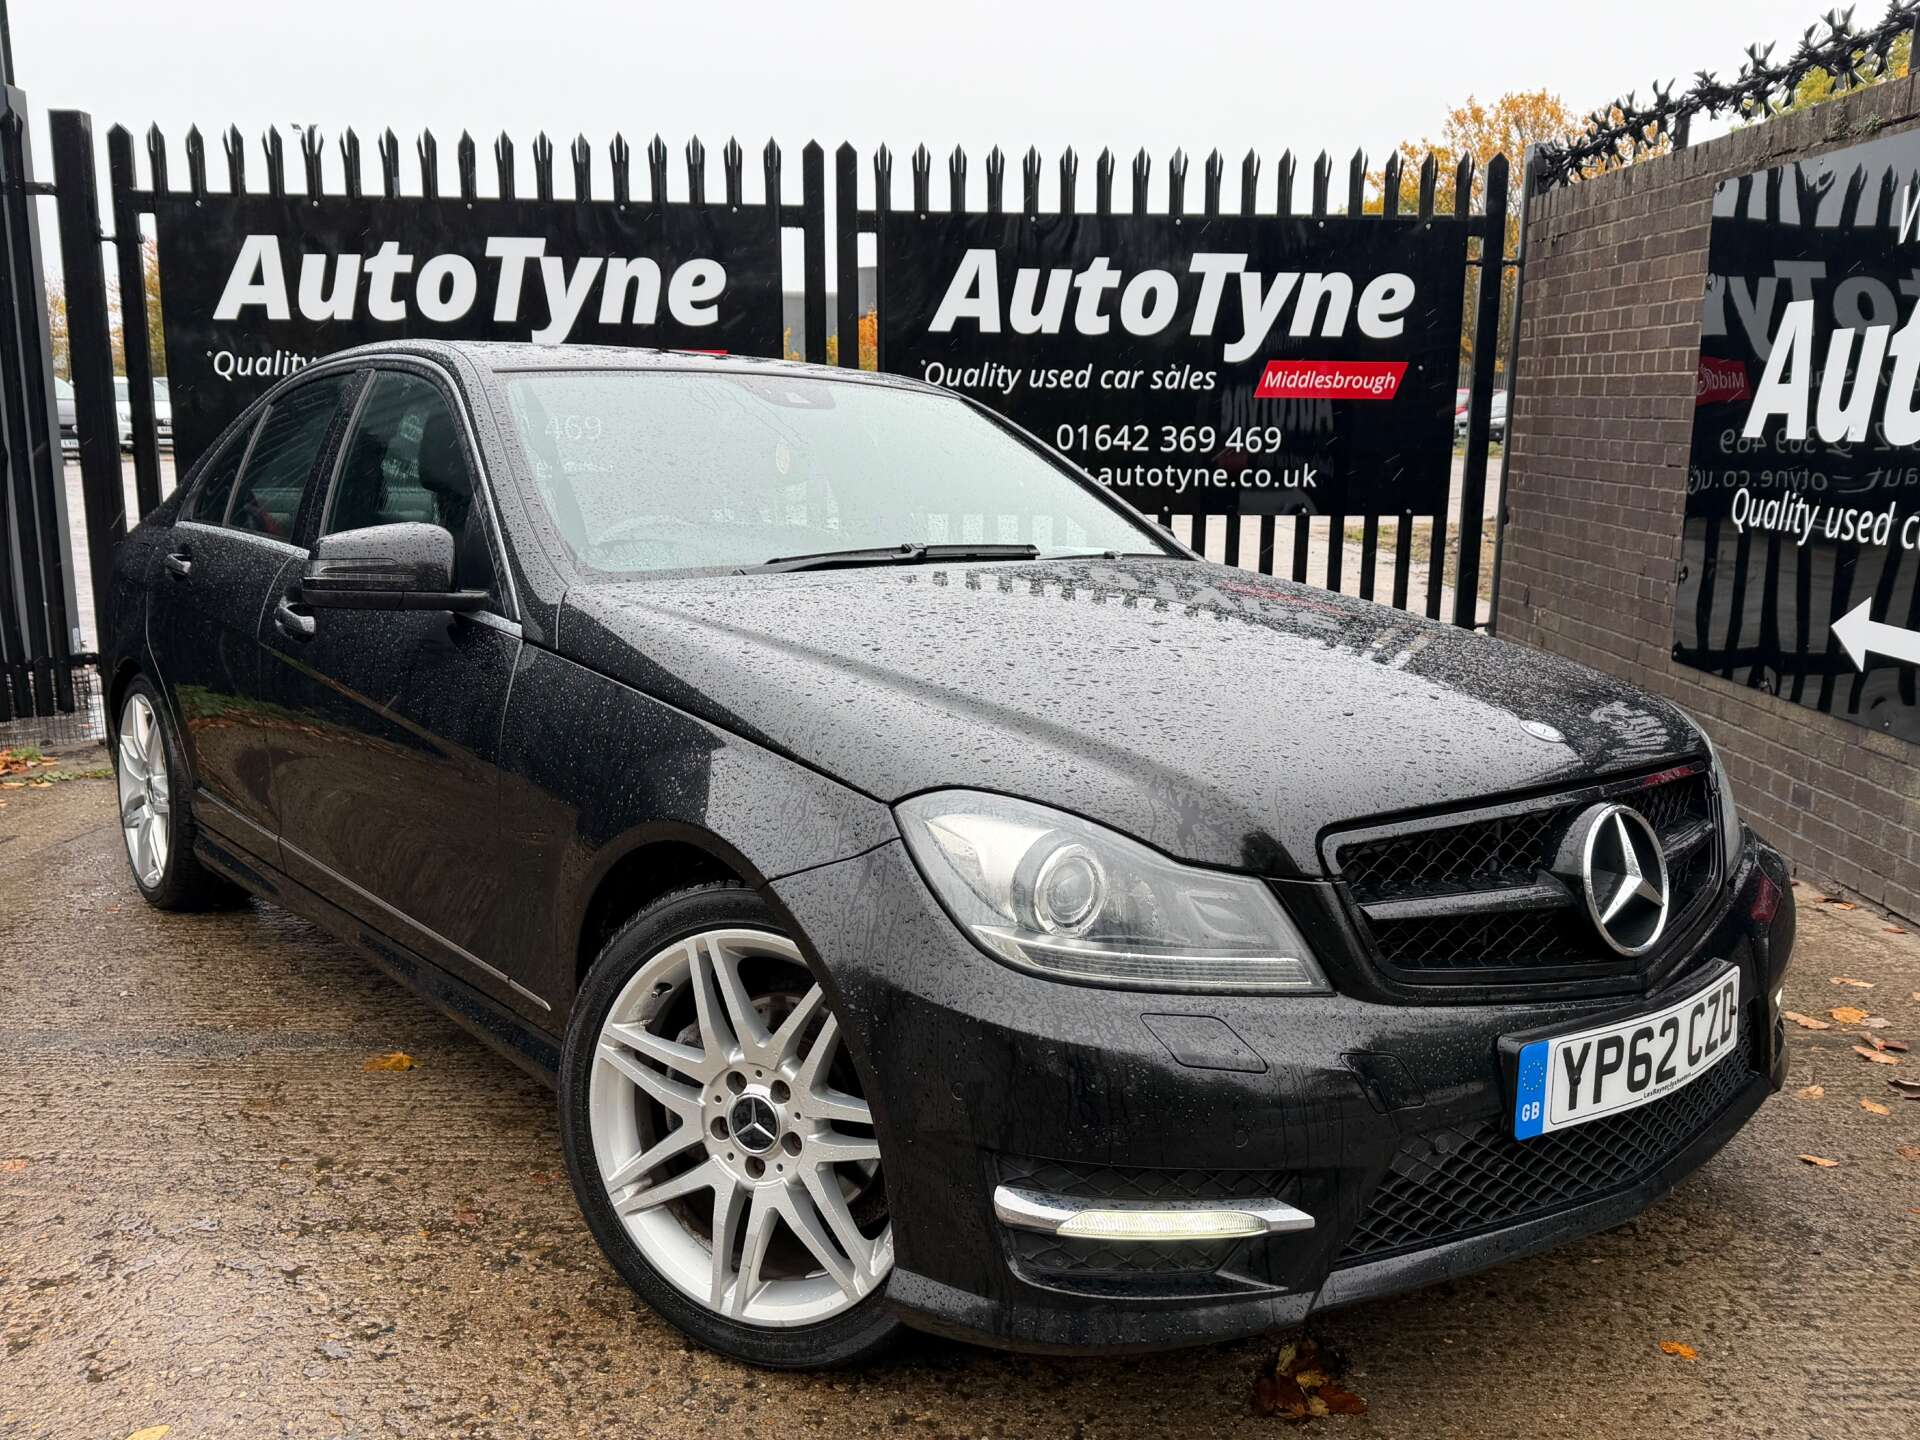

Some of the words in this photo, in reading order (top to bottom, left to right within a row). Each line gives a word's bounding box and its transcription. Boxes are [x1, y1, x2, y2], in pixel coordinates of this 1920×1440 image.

[213, 235, 727, 344] AutoTyne
[928, 248, 1415, 364] AutoTyne
[925, 362, 1022, 394] Quality
[1030, 363, 1093, 389] used
[1100, 368, 1145, 389] car
[1150, 364, 1217, 390] sales
[1264, 370, 1396, 394] Middlesbrough
[1056, 424, 1149, 452] 01642
[1160, 426, 1216, 453] 369
[1225, 427, 1282, 453] 469
[1084, 462, 1317, 494] autotyne.co.uk
[1731, 487, 1821, 546] Quality
[1824, 501, 1897, 546] used
[1901, 515, 1920, 550] c
[1563, 1016, 1680, 1111] YP62
[1687, 981, 1735, 1067] CZD
[1521, 1101, 1540, 1122] GB
